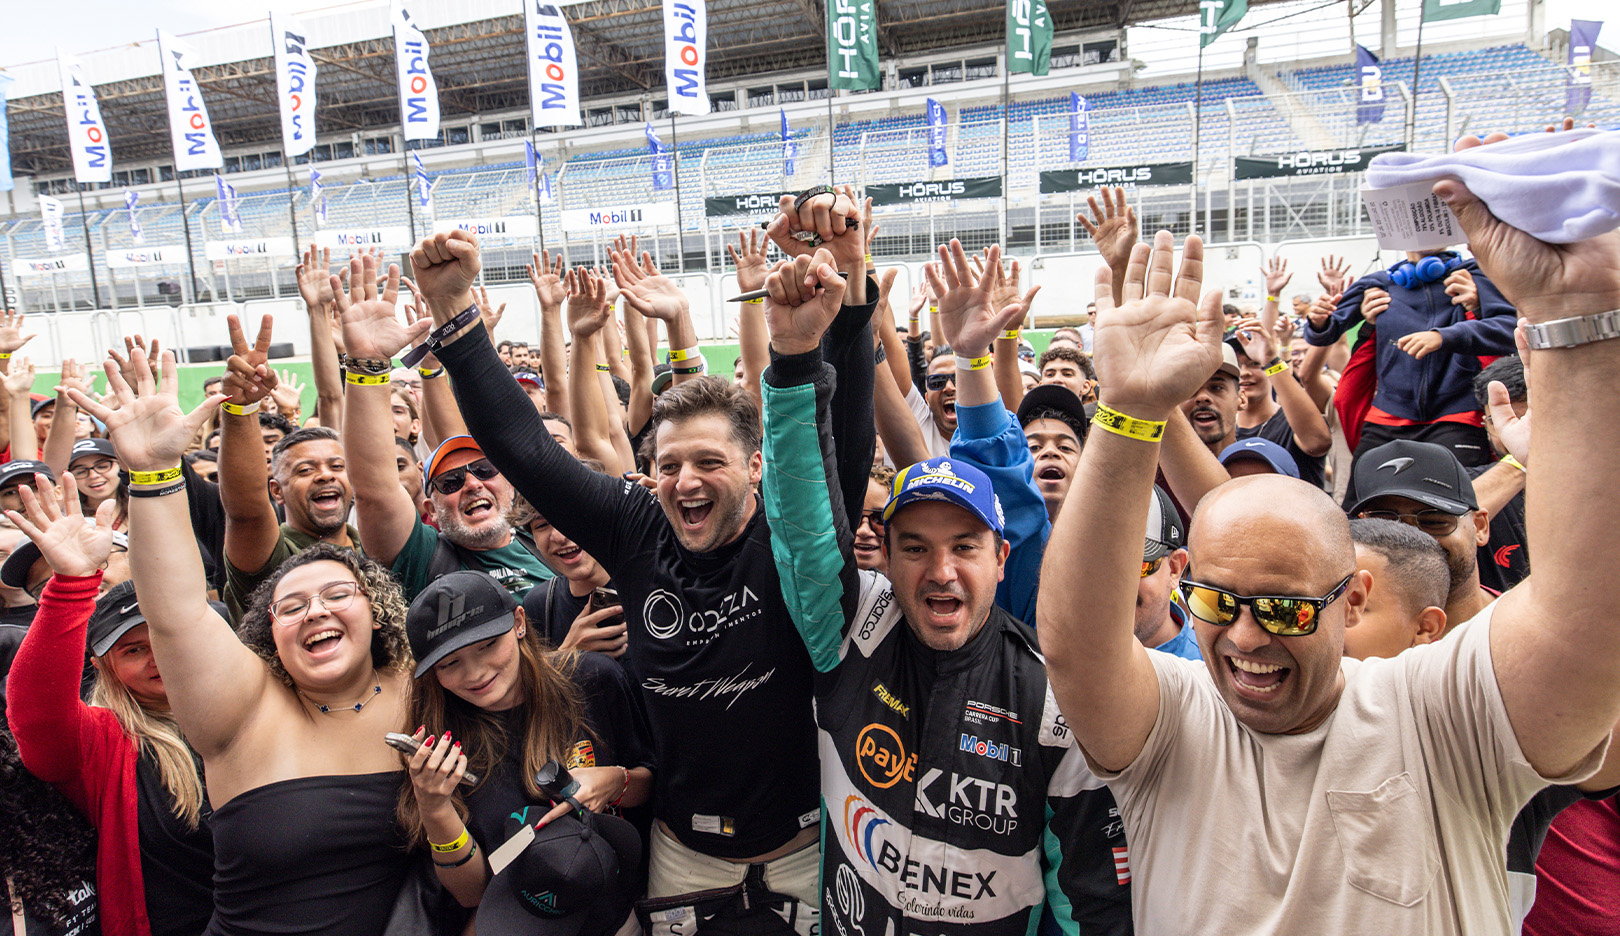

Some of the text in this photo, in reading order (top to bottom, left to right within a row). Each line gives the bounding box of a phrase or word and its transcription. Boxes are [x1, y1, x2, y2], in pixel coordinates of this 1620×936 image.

[673, 3, 700, 98] Mobil
[404, 41, 428, 123] Mobil
[537, 25, 566, 109] Mobil
[1296, 165, 1343, 175] AVIATION
[914, 195, 951, 203] AVIATION
[458, 222, 493, 235] Mobil
[590, 210, 627, 225] Mobil
[338, 232, 369, 245] Mobil
[906, 476, 975, 495] MICHELIN
[860, 588, 893, 641] sparco
[873, 684, 910, 717] FREMAX
[967, 700, 1018, 720] PORSCHE
[964, 715, 983, 725] BRASIL
[965, 710, 1000, 723] CARRERA CUP
[960, 732, 1009, 762] Mobil
[950, 772, 1018, 818] KTR
[949, 806, 1018, 836] GROUP
[877, 839, 997, 901] BENEX
[897, 890, 976, 920] Colorindo vidas
